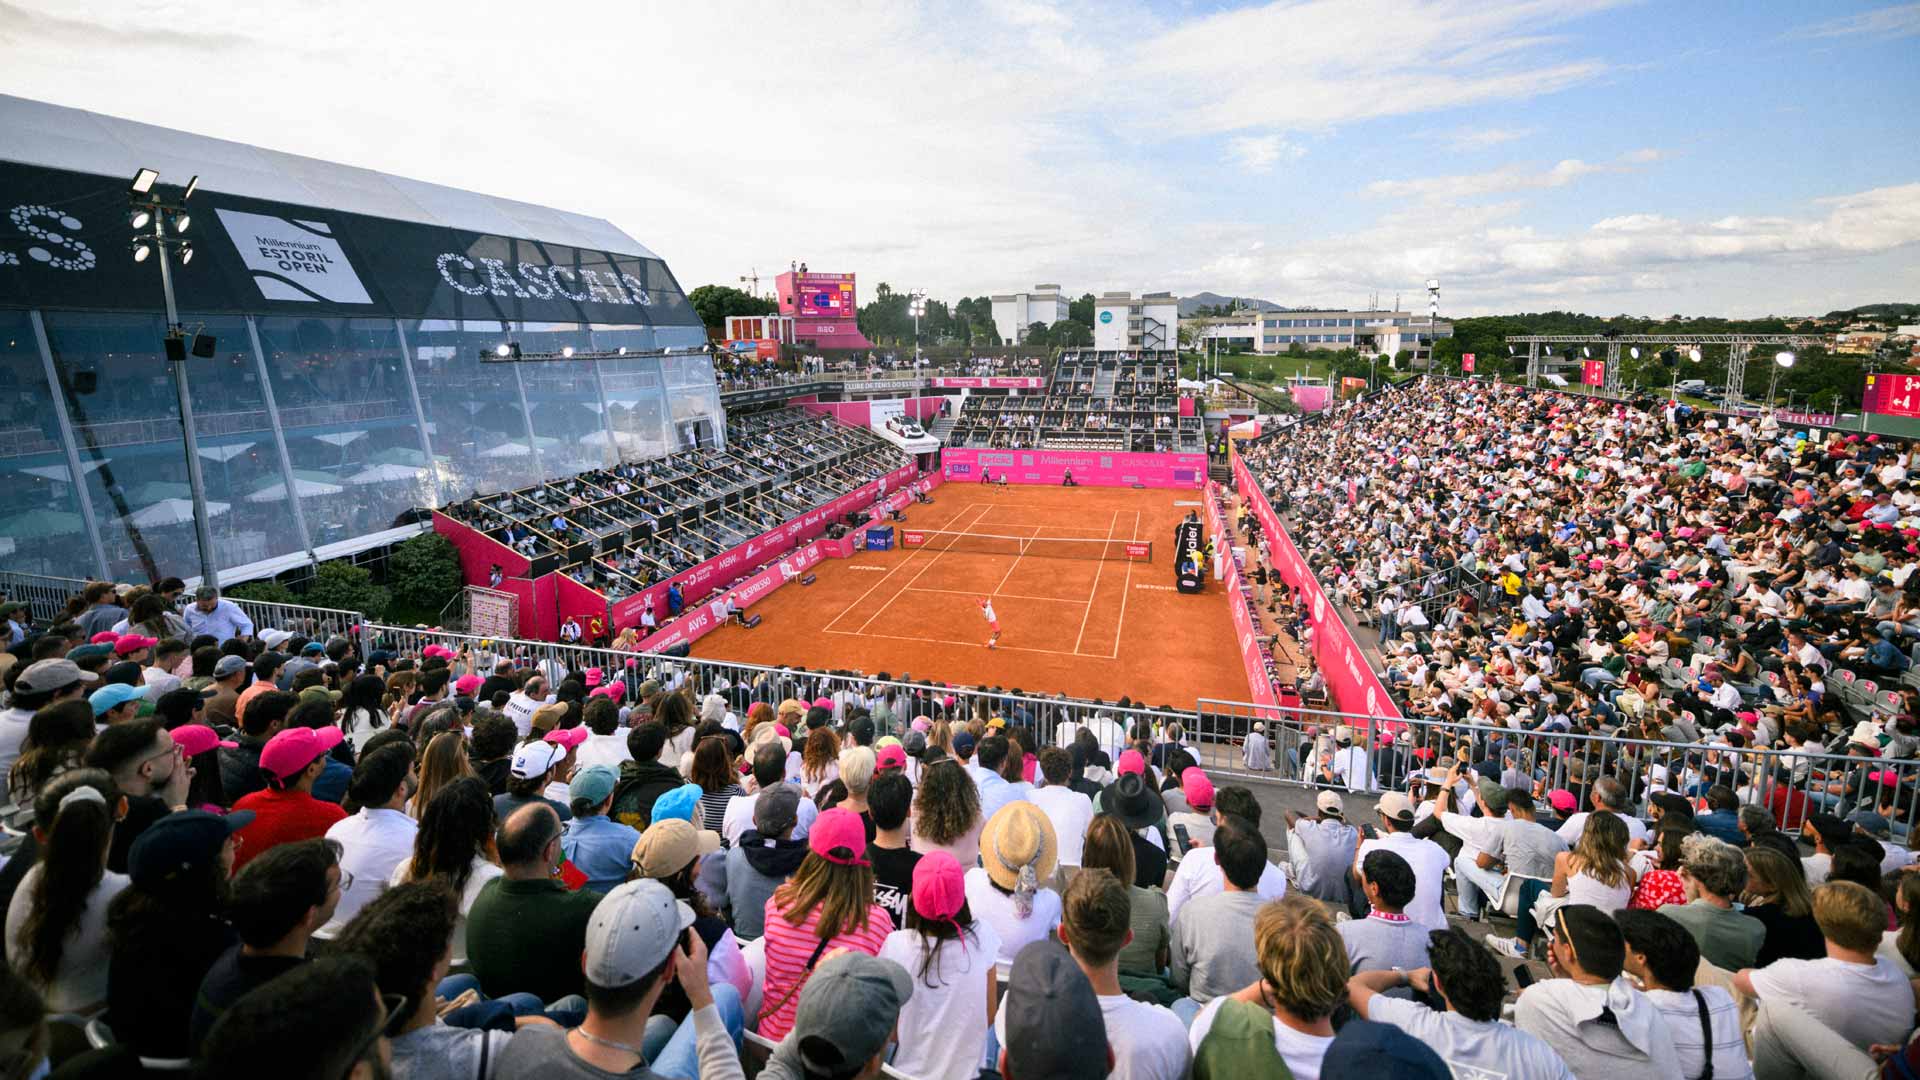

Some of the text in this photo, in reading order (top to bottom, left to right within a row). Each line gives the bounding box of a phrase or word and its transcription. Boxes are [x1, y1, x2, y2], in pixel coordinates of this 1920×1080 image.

[0, 204, 96, 271] S
[255, 235, 321, 250] Millennium
[259, 246, 334, 264] ESTORIL
[278, 260, 328, 274] OPEN
[436, 252, 652, 306] CASCAIS
[1905, 377, 1913, 392] 3
[1902, 395, 1911, 409] 4
[1040, 455, 1093, 465] Millennium
[1186, 526, 1198, 558] Haier
[739, 576, 771, 601] NESPRESSO
[688, 614, 708, 633] AVIS
